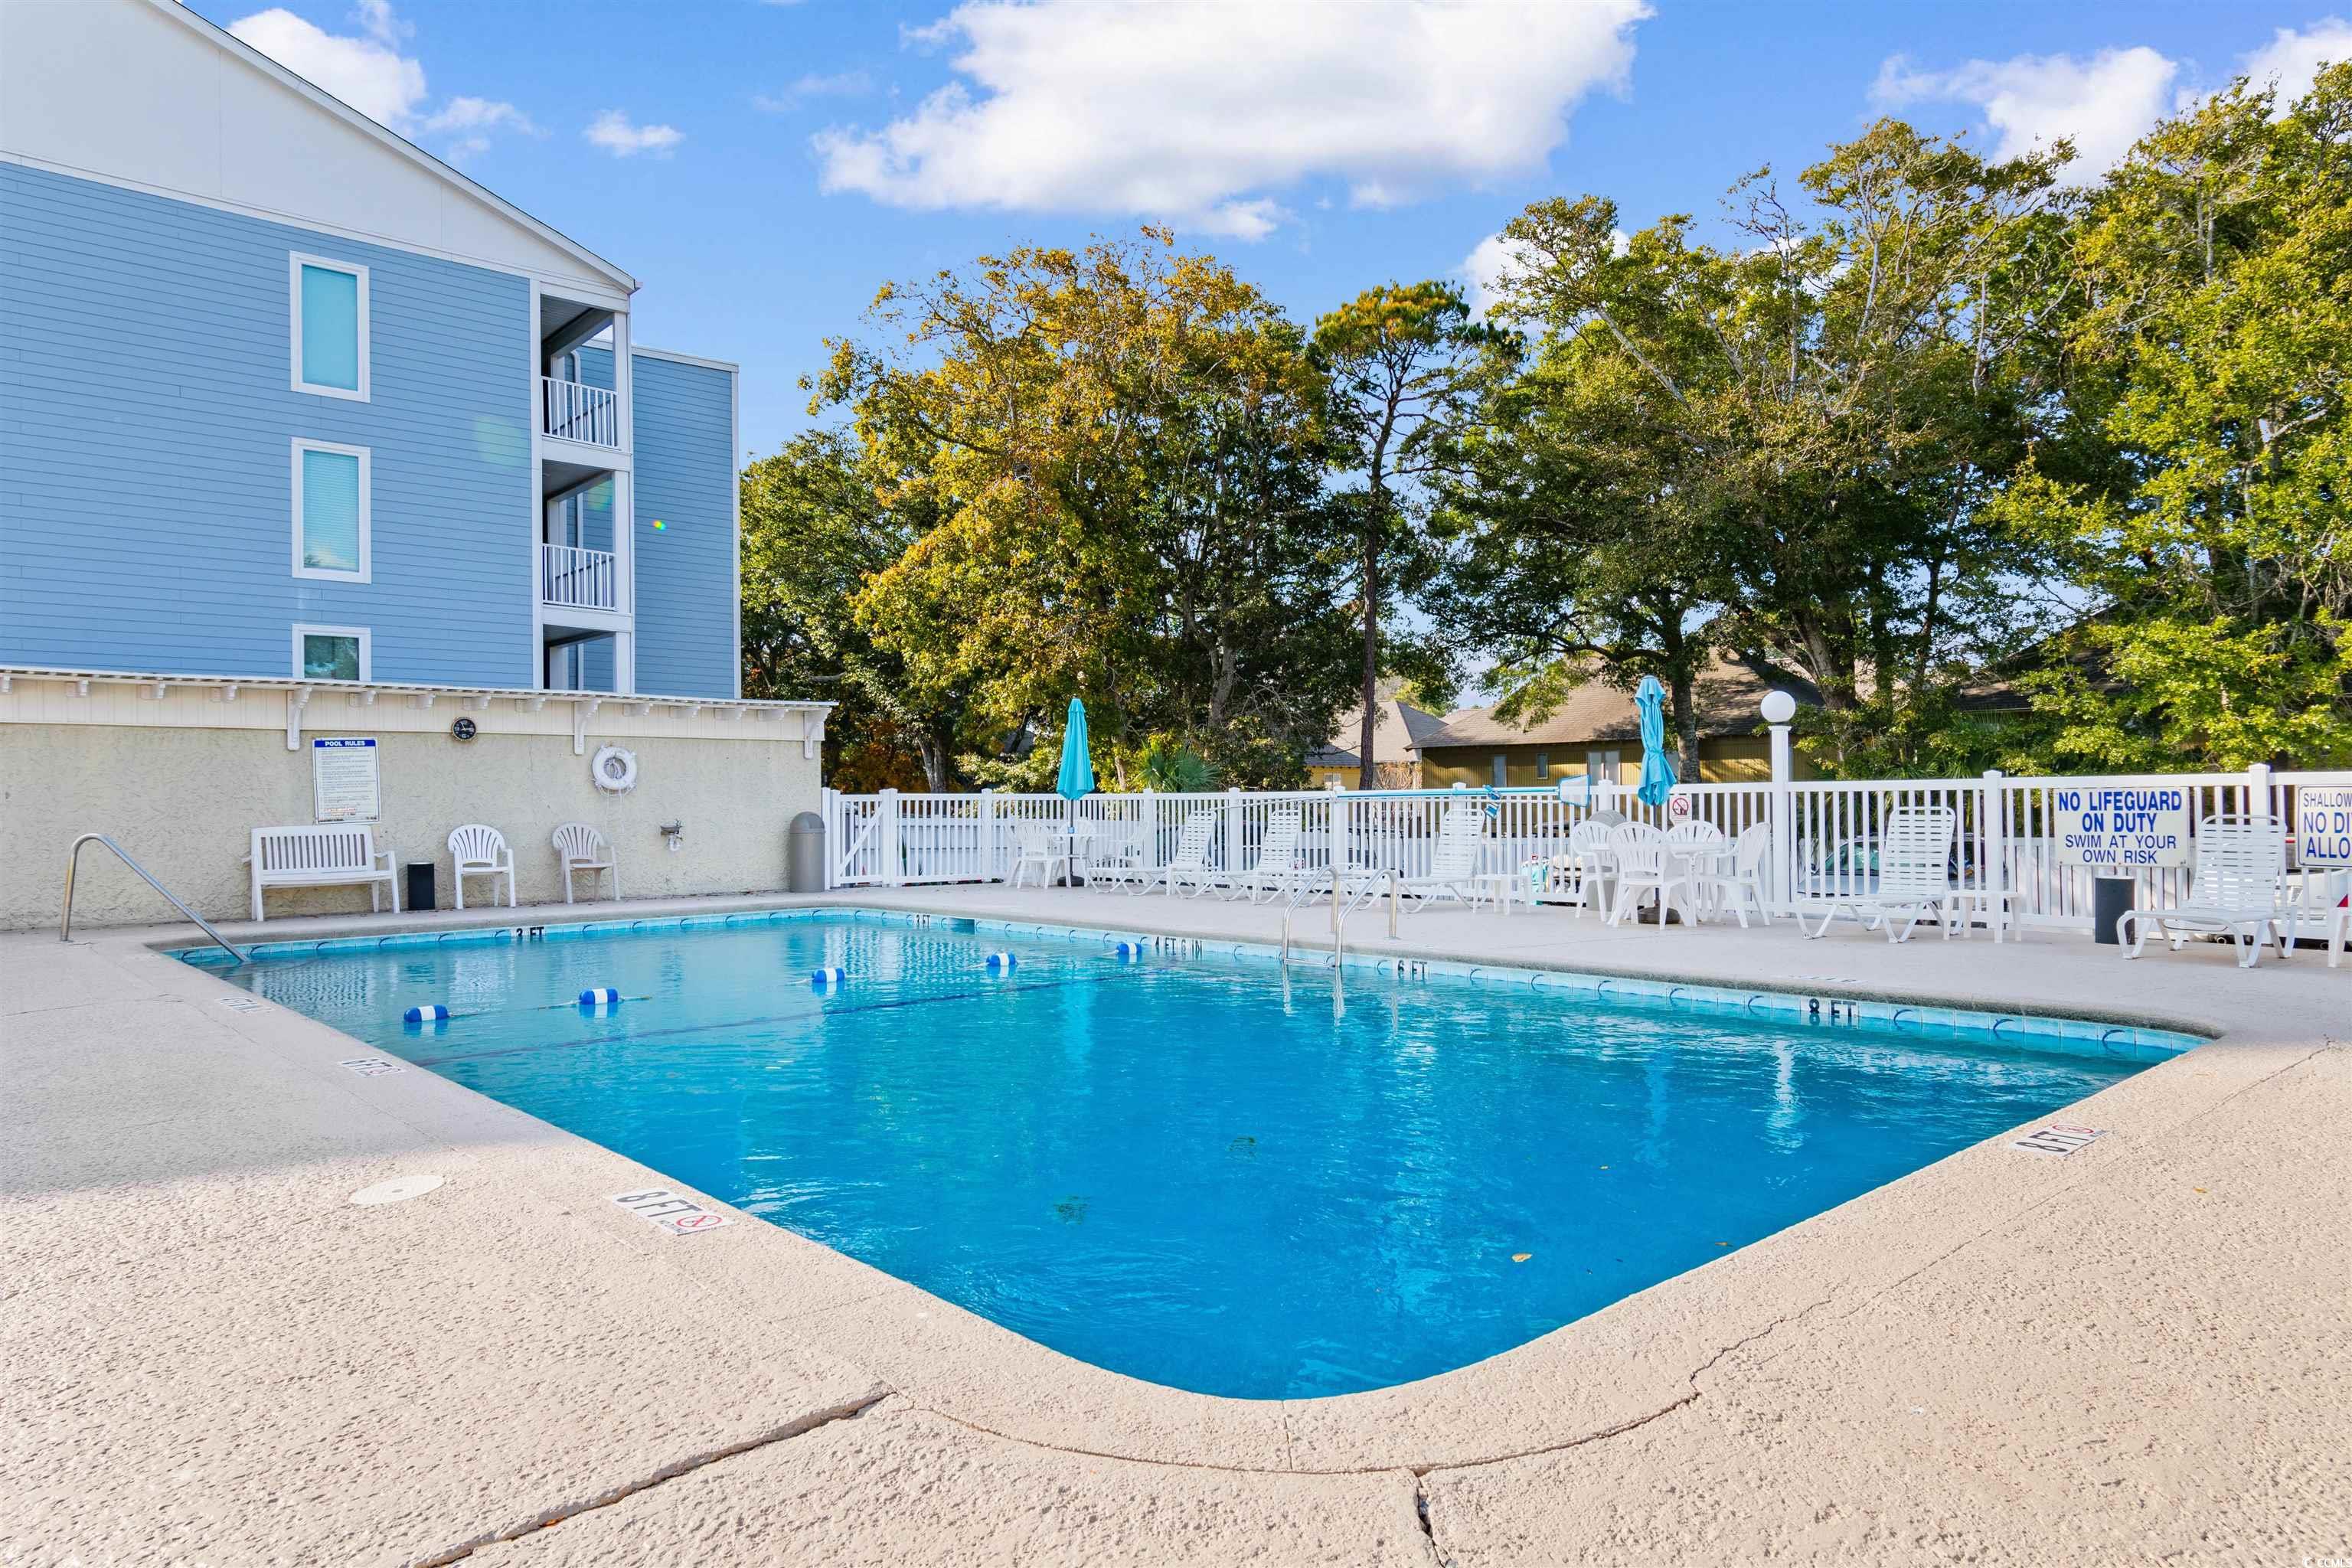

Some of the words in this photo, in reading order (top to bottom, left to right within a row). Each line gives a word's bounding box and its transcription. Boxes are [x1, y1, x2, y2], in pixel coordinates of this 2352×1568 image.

[2058, 792, 2080, 811] NO
[2089, 791, 2182, 812] LIFEGUARD
[2082, 812, 2104, 832] ON
[2114, 812, 2157, 832] DUTY
[2304, 812, 2327, 833] NO
[2334, 812, 2352, 833] DI
[2065, 835, 2102, 848] SWIM
[2109, 835, 2127, 848] AT
[2135, 835, 2177, 849] YOUR
[2082, 849, 2116, 863] OWN
[2124, 850, 2158, 864] RISK
[1831, 999, 1857, 1017] FT
[2029, 1131, 2089, 1145] FT
[2015, 1142, 2068, 1152] 8
[616, 1191, 668, 1202] 8
[633, 1199, 703, 1217] FT
